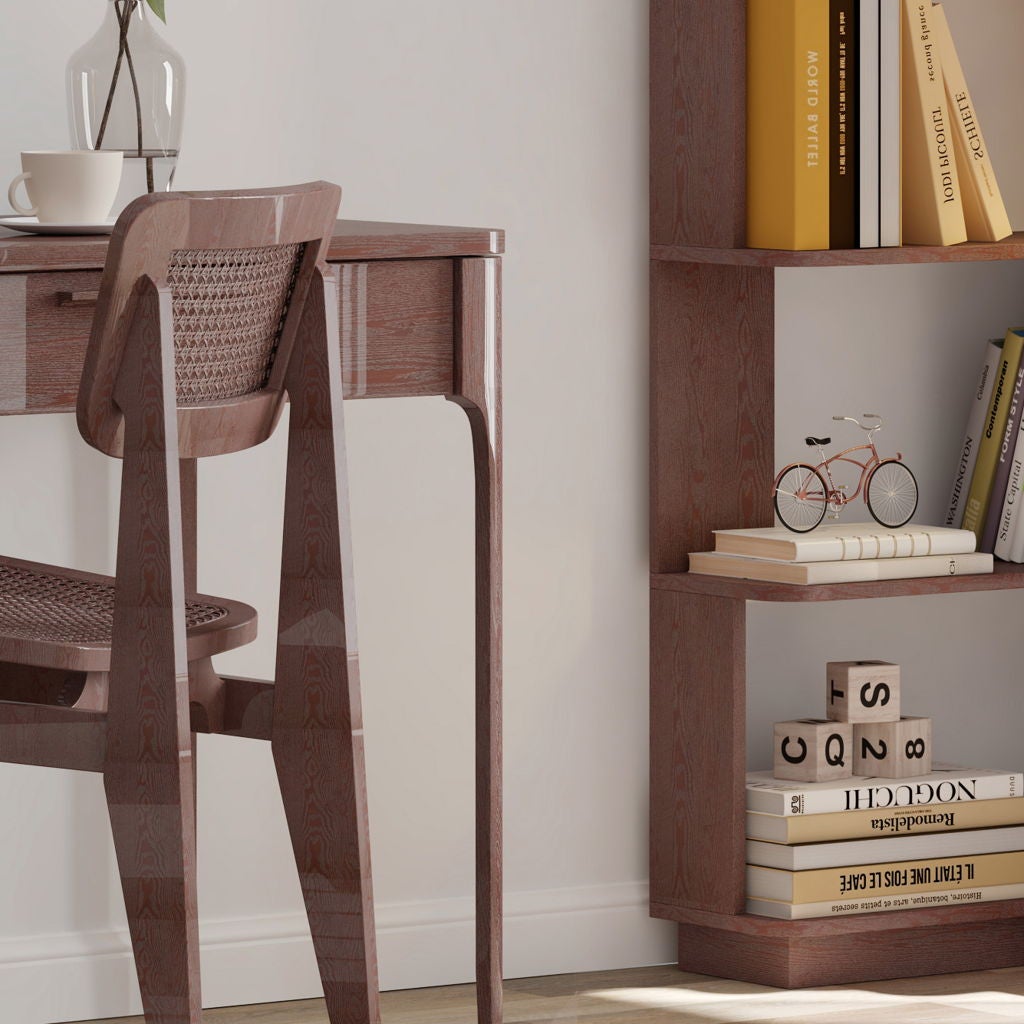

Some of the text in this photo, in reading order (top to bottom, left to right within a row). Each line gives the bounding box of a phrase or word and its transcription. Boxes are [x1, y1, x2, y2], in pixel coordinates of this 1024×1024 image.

[1000, 367, 1024, 463] FORM STYLE
[946, 436, 973, 525] WASHINGTON
[1000, 508, 1011, 541] State
[1007, 459, 1022, 505] Capital
[830, 680, 844, 705] T
[860, 682, 890, 707] S
[781, 736, 807, 763] C
[825, 733, 845, 767] Q
[861, 738, 887, 760] 2
[905, 738, 925, 759] 8
[843, 779, 977, 810] NOGUCHI
[870, 813, 955, 832] Remodelista
[839, 863, 975, 895] IL ÉTAIT UNE FOIS LE CAFÉ
[831, 891, 982, 913] Histoire, botanique, arts et petits secrets
